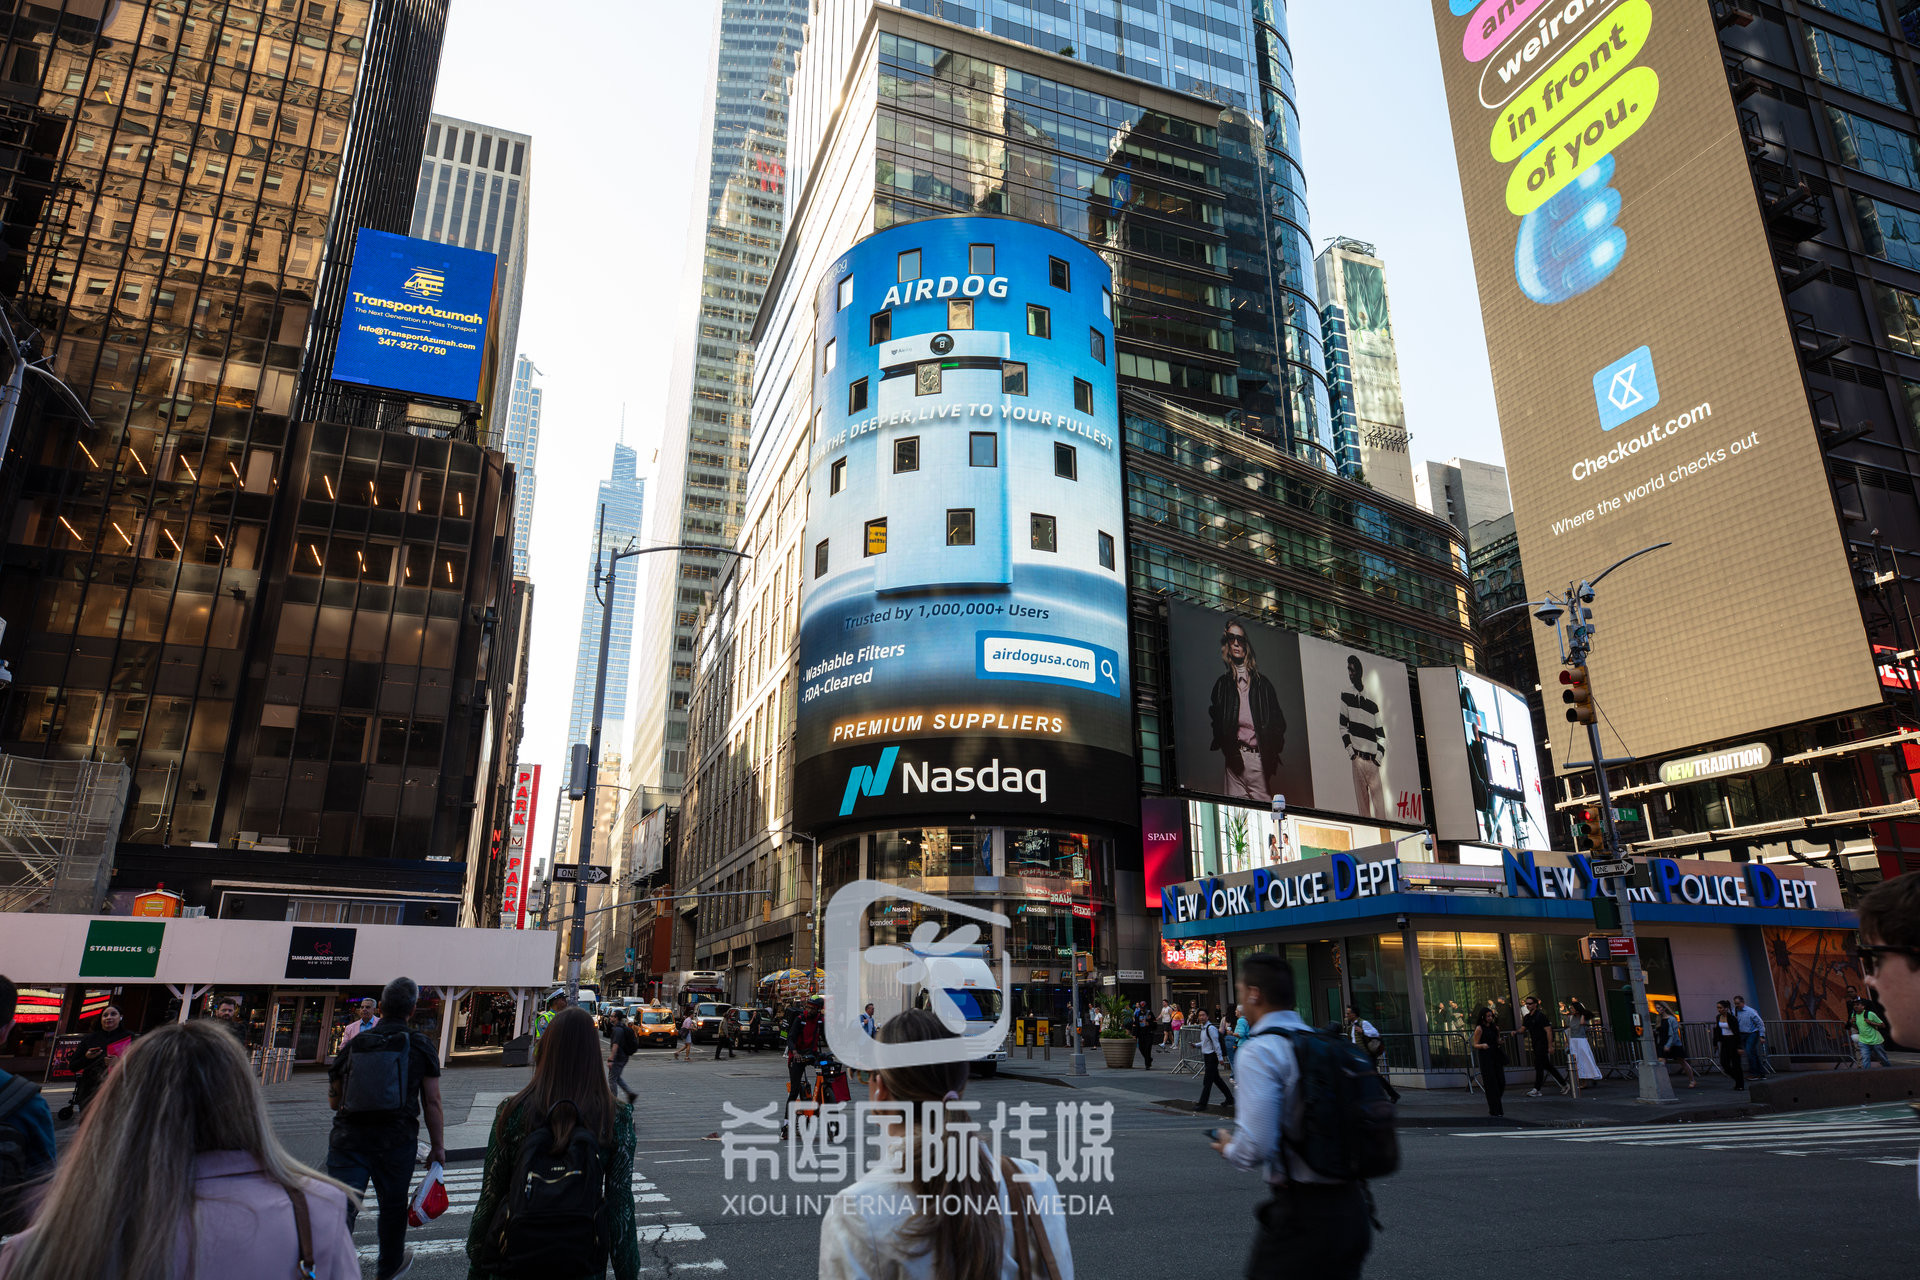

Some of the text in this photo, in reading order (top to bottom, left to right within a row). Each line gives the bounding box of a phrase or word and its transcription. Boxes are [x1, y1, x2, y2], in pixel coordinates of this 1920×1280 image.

[1507, 22, 1628, 142] in front
[1527, 98, 1639, 192] of you.
[353, 291, 483, 325] TransportAzumah
[880, 275, 1009, 310] AIRDOG
[368, 309, 383, 317] Next
[385, 313, 421, 323] Generation
[429, 320, 445, 328] Mass
[447, 323, 477, 333] Transport
[378, 337, 447, 356] 347-927-0750
[969, 402, 993, 418] TO
[1001, 405, 1053, 426] YOUR
[1057, 415, 1113, 450] FULLEST
[1571, 402, 1713, 481] Checkout.com
[1552, 431, 1760, 536] Where the world checks out
[845, 602, 1050, 630] Trusted by 1,000,000+ Users
[805, 642, 905, 683] Washable Filters
[992, 648, 1090, 671] airdogusa.com
[804, 667, 873, 704] FDA-Cleared
[833, 712, 1063, 742] PREMIUM SUPPLIERS
[902, 758, 1047, 803] Nasdaq
[513, 772, 530, 825] PARK
[1396, 790, 1423, 822] H&M
[1147, 832, 1177, 841] SPAIN
[562, 869, 578, 877] ONE
[1595, 863, 1628, 873] ONE WAY
[503, 857, 521, 913] PARK
[892, 906, 911, 914] Nasdaq
[1026, 905, 1047, 914] Nasdaq
[90, 945, 142, 953] STARBUCKS
